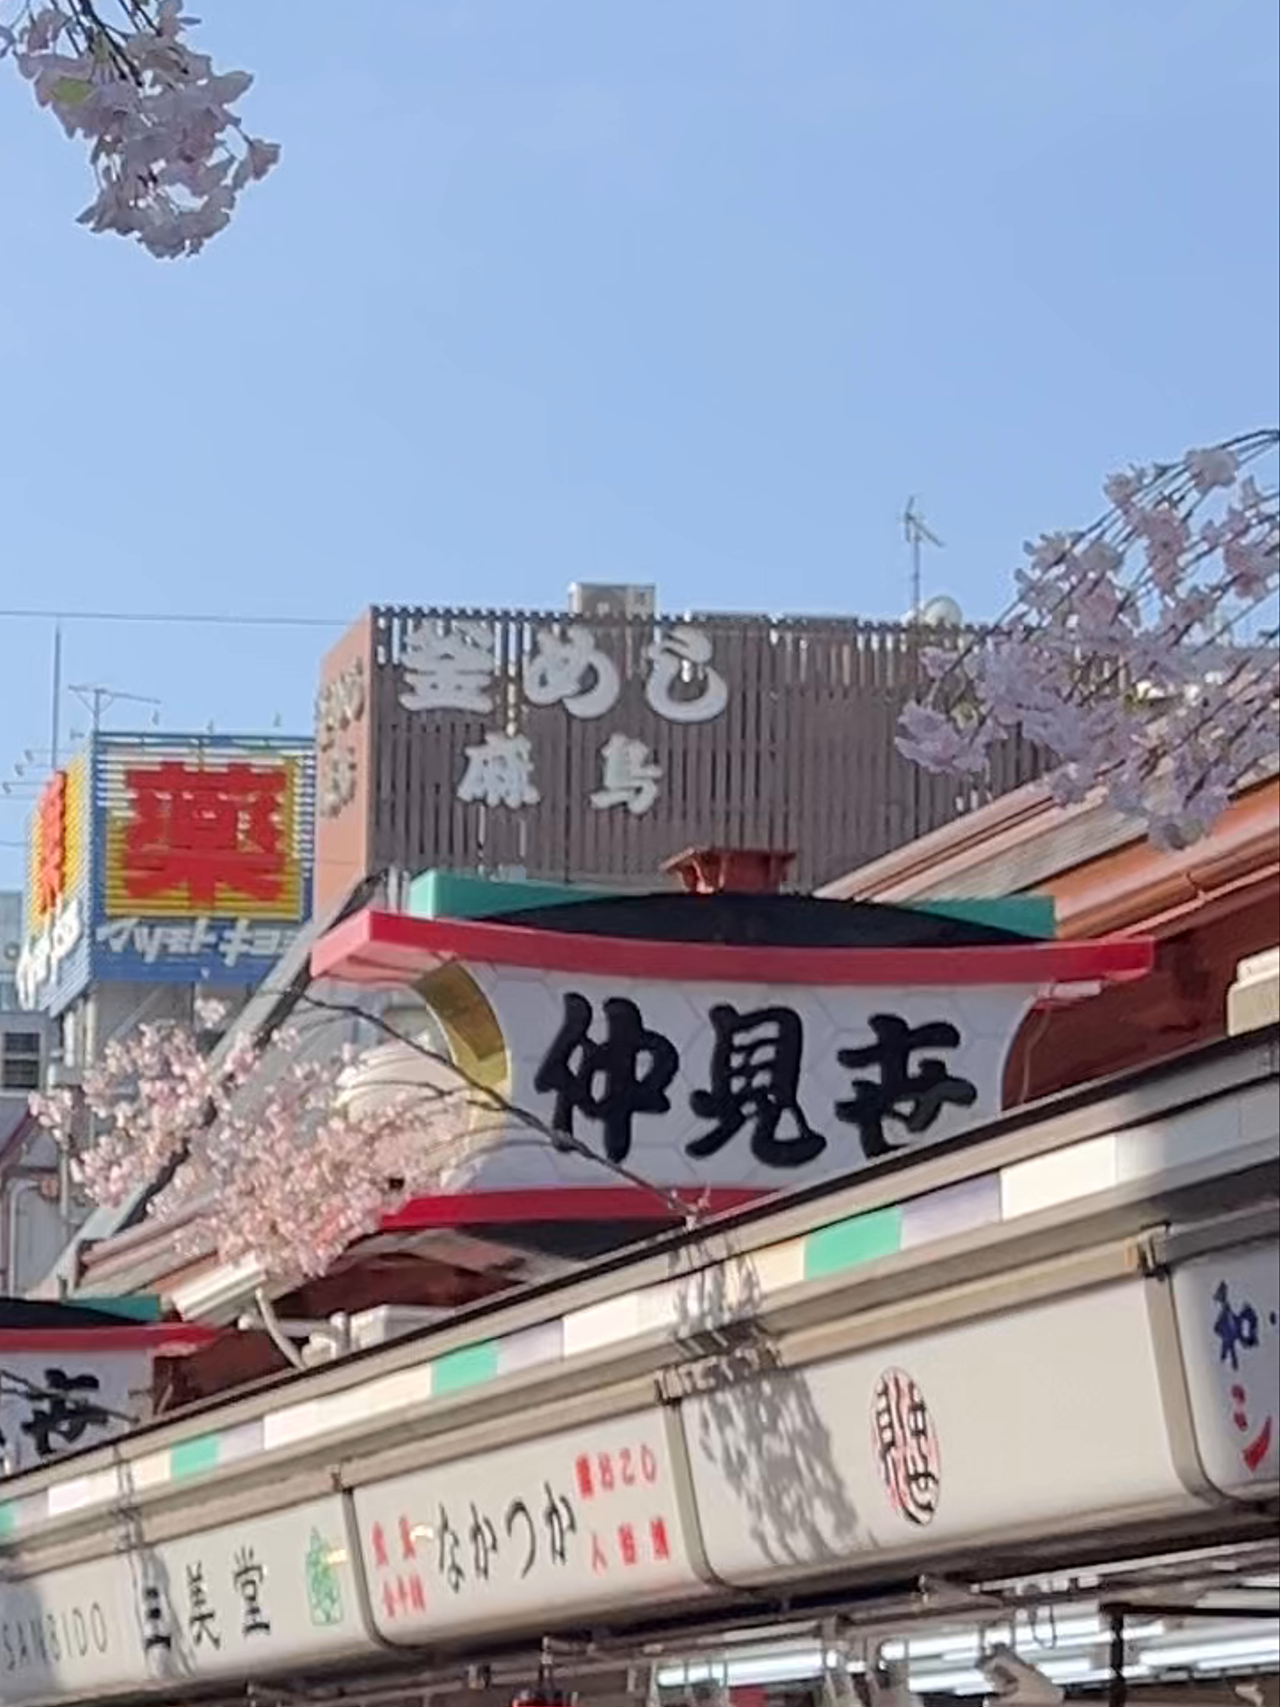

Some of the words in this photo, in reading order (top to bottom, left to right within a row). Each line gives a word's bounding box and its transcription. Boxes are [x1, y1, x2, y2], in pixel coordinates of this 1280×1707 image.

[399, 618, 728, 723] 釜めし
[124, 761, 290, 908] 薬
[535, 991, 978, 1169] 仲見世
[438, 1481, 577, 1593] なかつか
